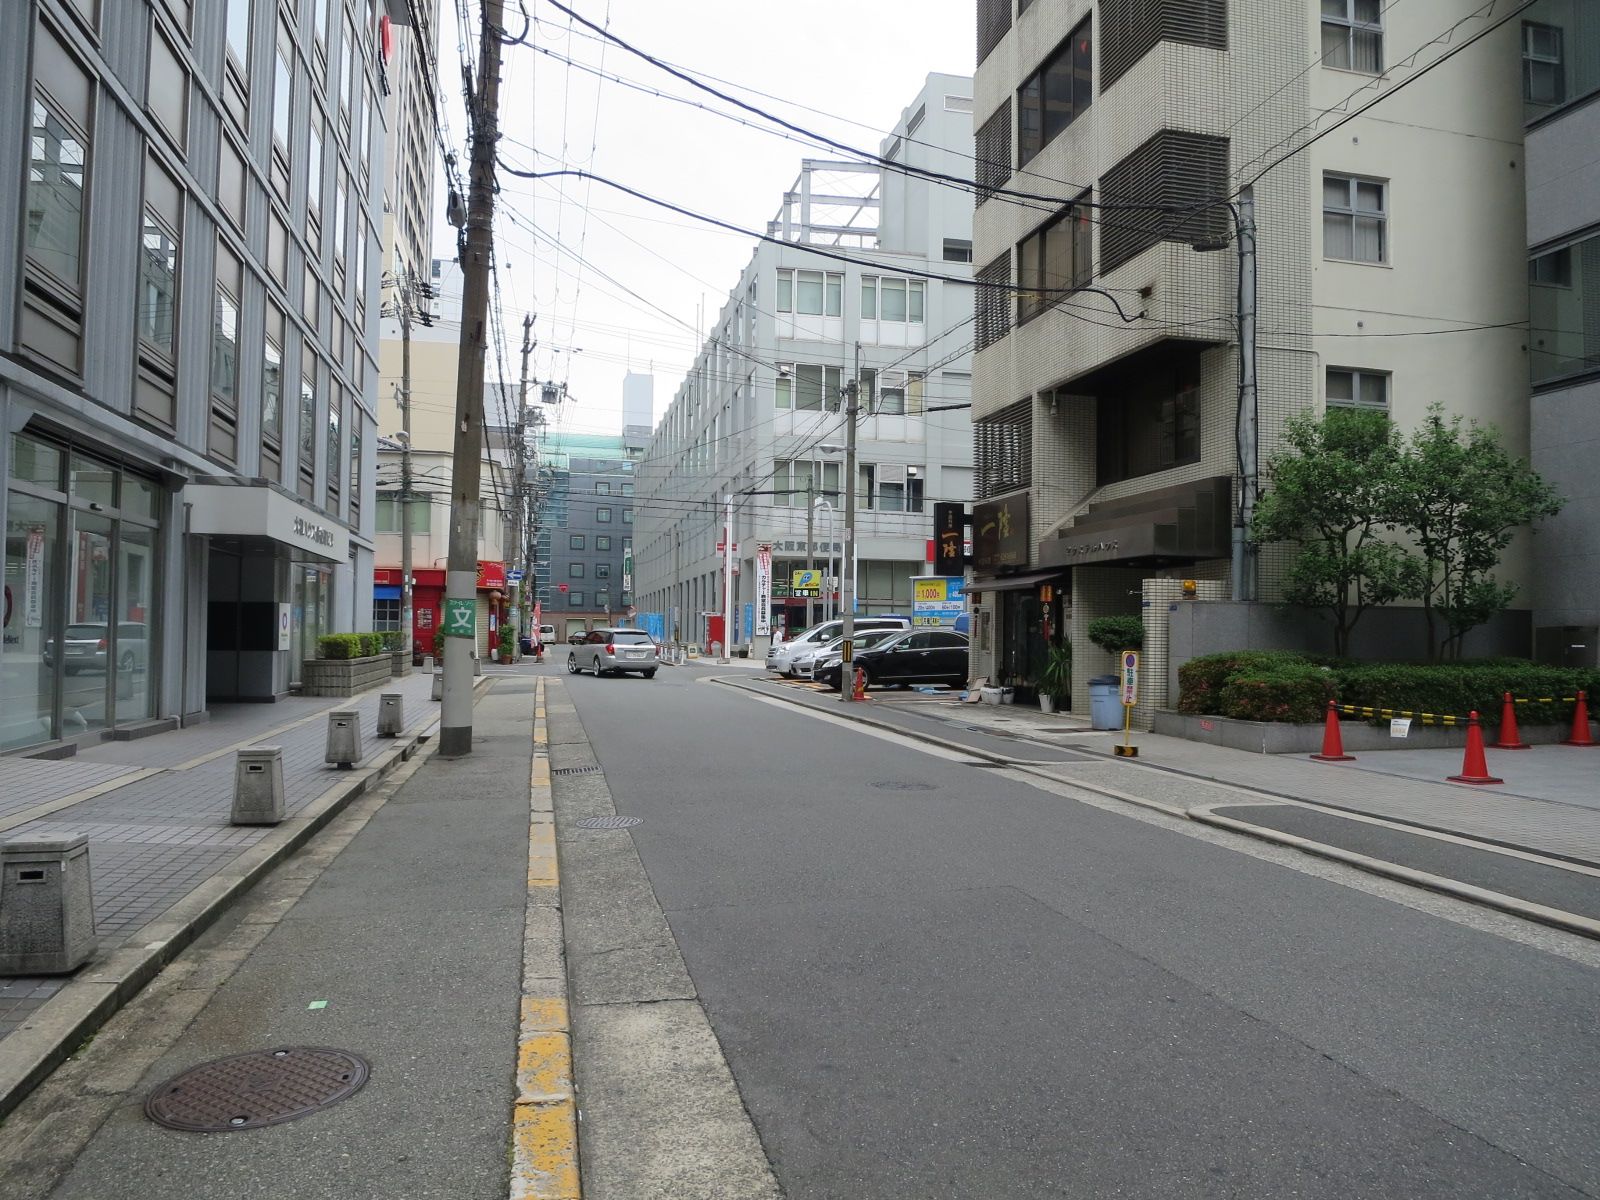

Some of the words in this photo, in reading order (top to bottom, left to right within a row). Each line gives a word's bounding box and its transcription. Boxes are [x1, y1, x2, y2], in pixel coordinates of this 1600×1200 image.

[451, 606, 472, 628] 文
[1125, 667, 1134, 704] 駐車禁止
